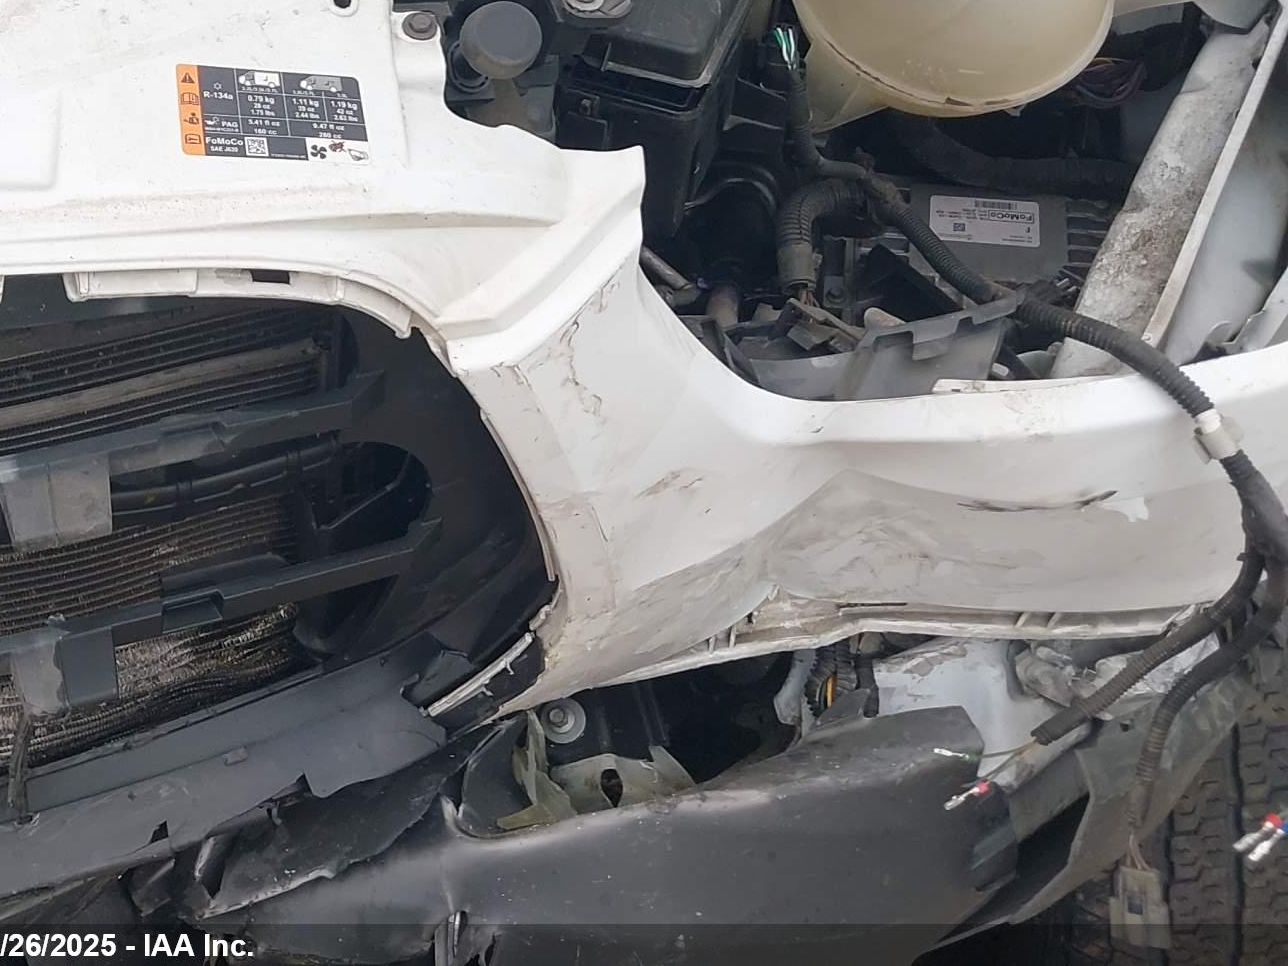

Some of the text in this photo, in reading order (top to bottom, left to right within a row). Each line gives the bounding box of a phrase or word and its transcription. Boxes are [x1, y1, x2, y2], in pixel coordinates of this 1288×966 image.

[203, 91, 233, 100] R-134a
[264, 95, 275, 104] kg
[309, 99, 319, 107] kg
[347, 102, 358, 110] kg
[221, 120, 239, 128] PAG
[205, 136, 244, 145] FoMoCo
[989, 211, 1033, 222] FoMoCo
